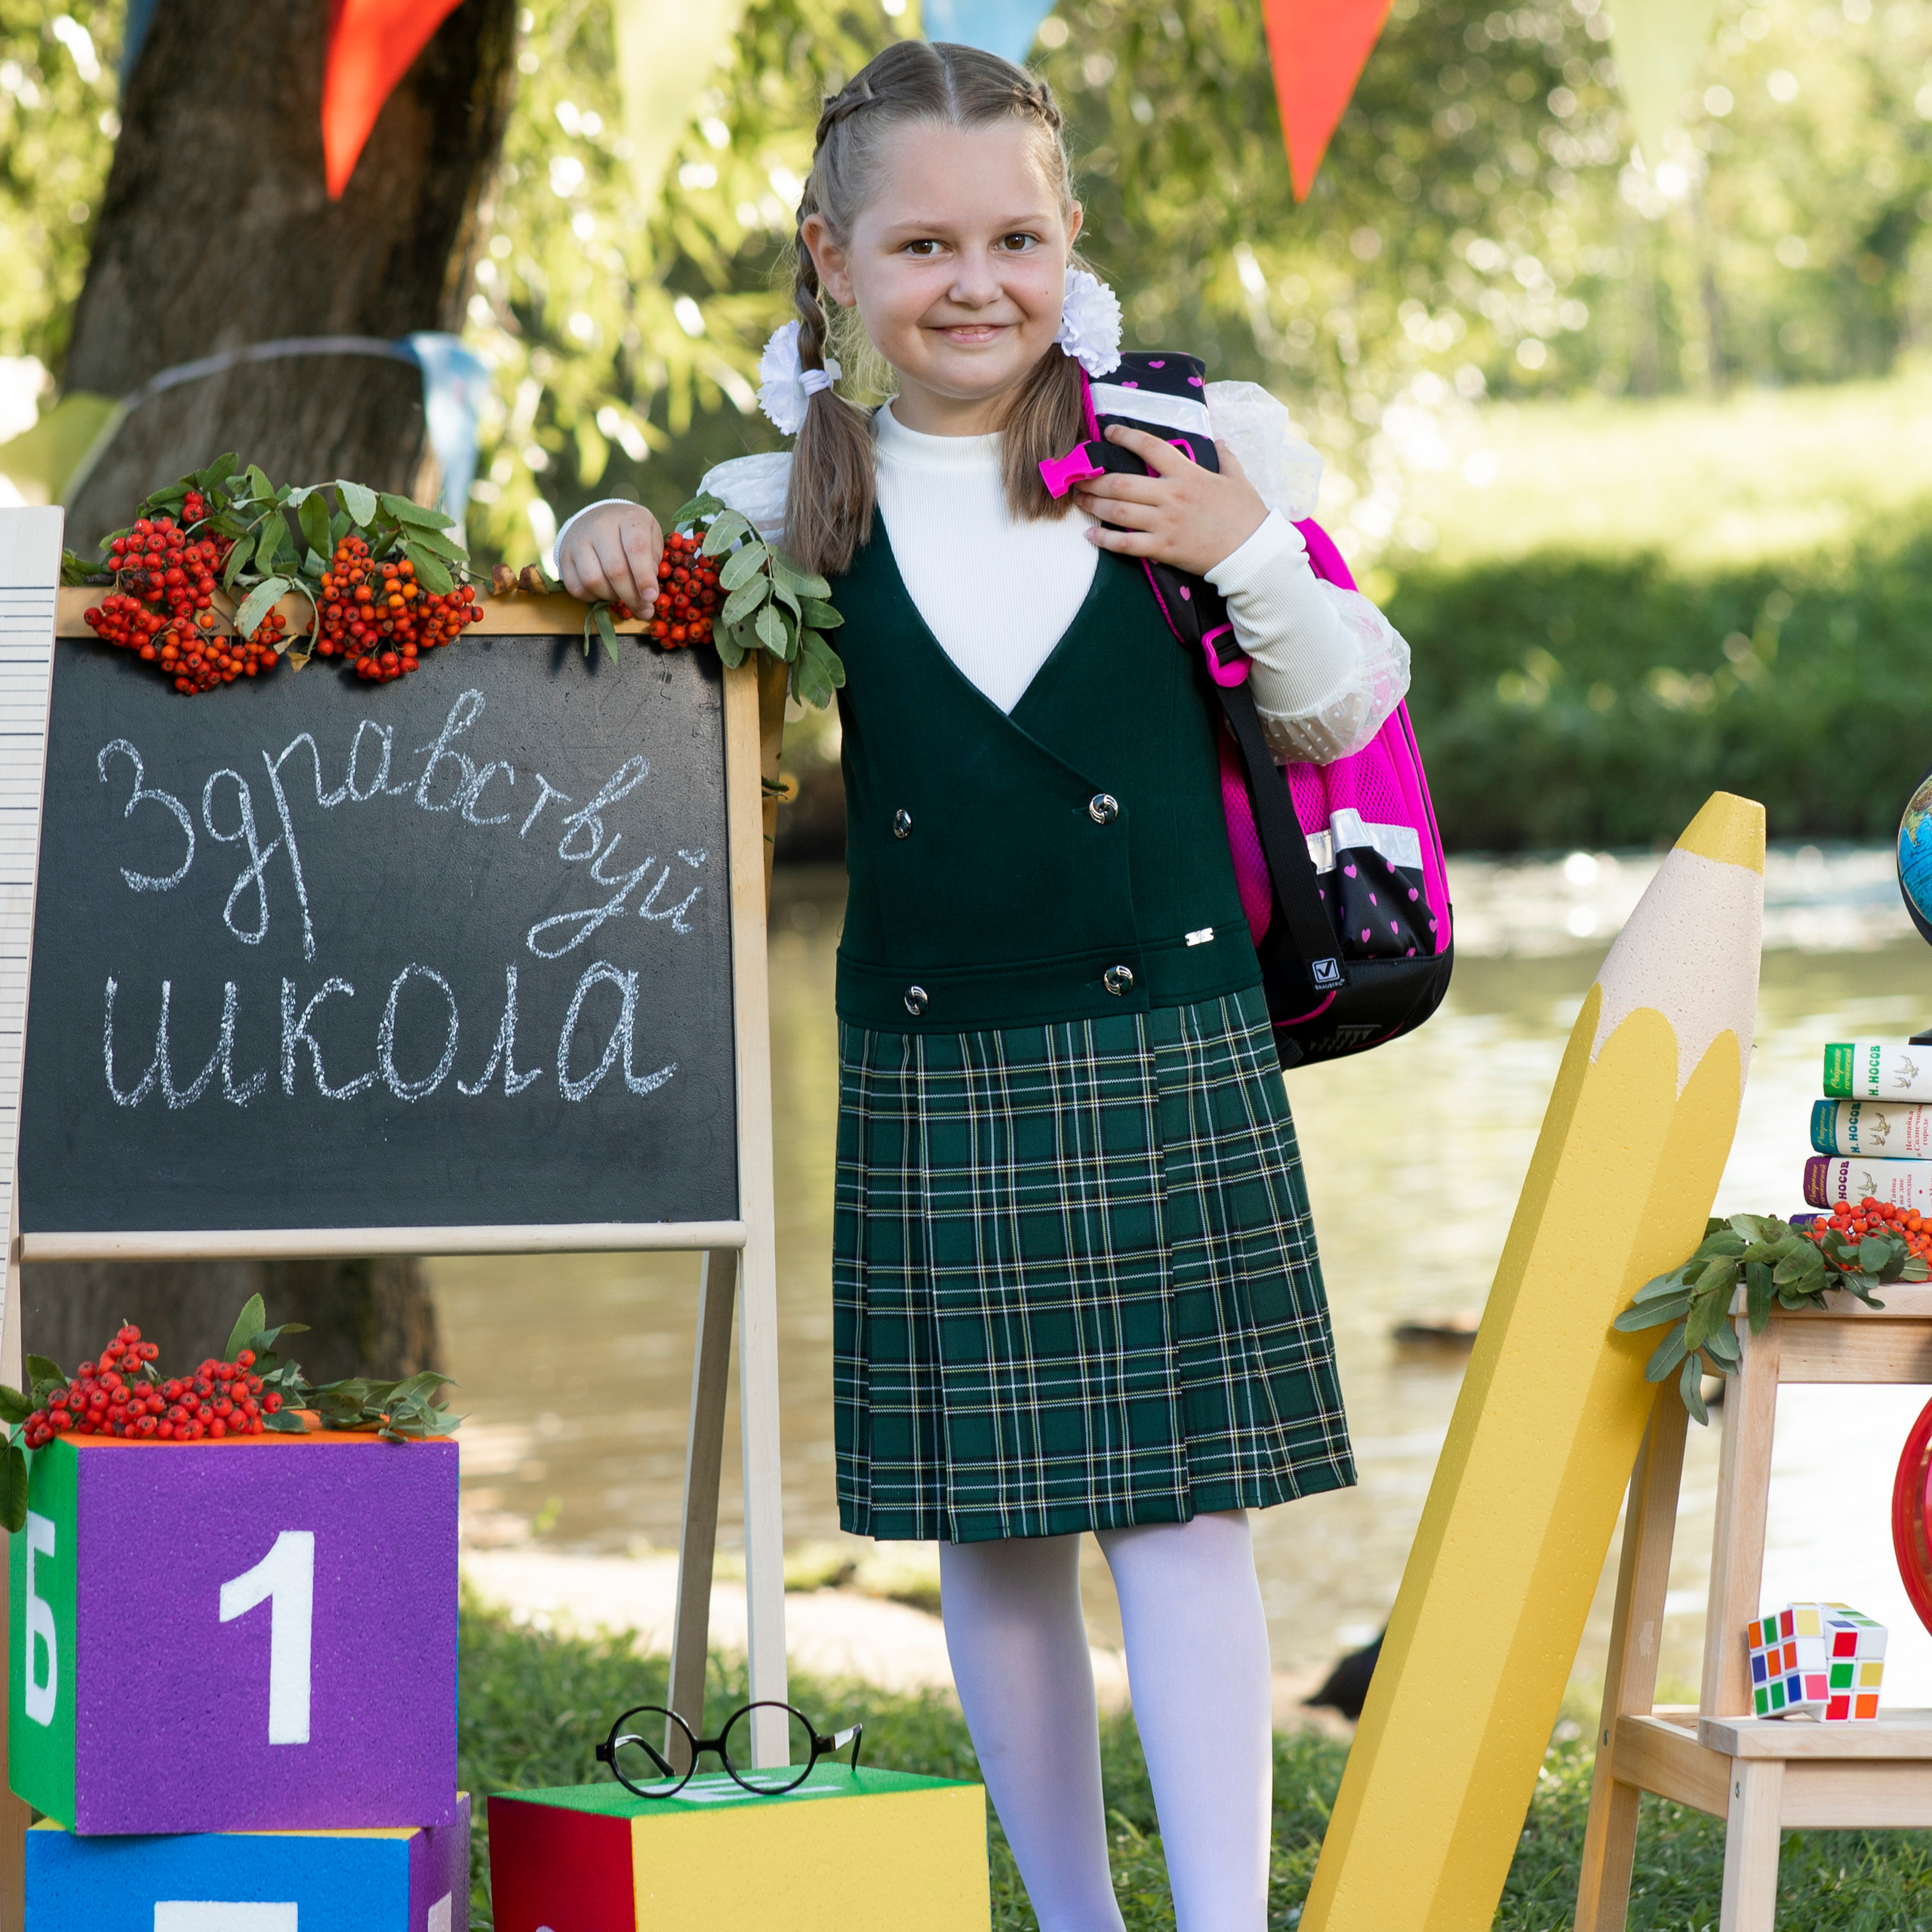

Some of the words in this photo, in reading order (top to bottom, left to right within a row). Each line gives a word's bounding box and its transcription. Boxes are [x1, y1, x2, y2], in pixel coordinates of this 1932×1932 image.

[1315, 981, 1343, 990] BRAUBERG
[1830, 1048, 1842, 1089] Собрание
[1844, 1048, 1852, 1091] сочинений
[1868, 1045, 1881, 1084] НОСОВ
[1816, 1106, 1827, 1146] Собрание
[1828, 1106, 1836, 1147] сочинений
[1848, 1102, 1861, 1142] НОСОВ
[1906, 1110, 1914, 1151] Незнайка
[1914, 1104, 1924, 1151] Солнечном
[1808, 1164, 1819, 1204] Собрание
[1838, 1160, 1850, 1200] НОСОВ
[220, 1531, 314, 1745] 1
